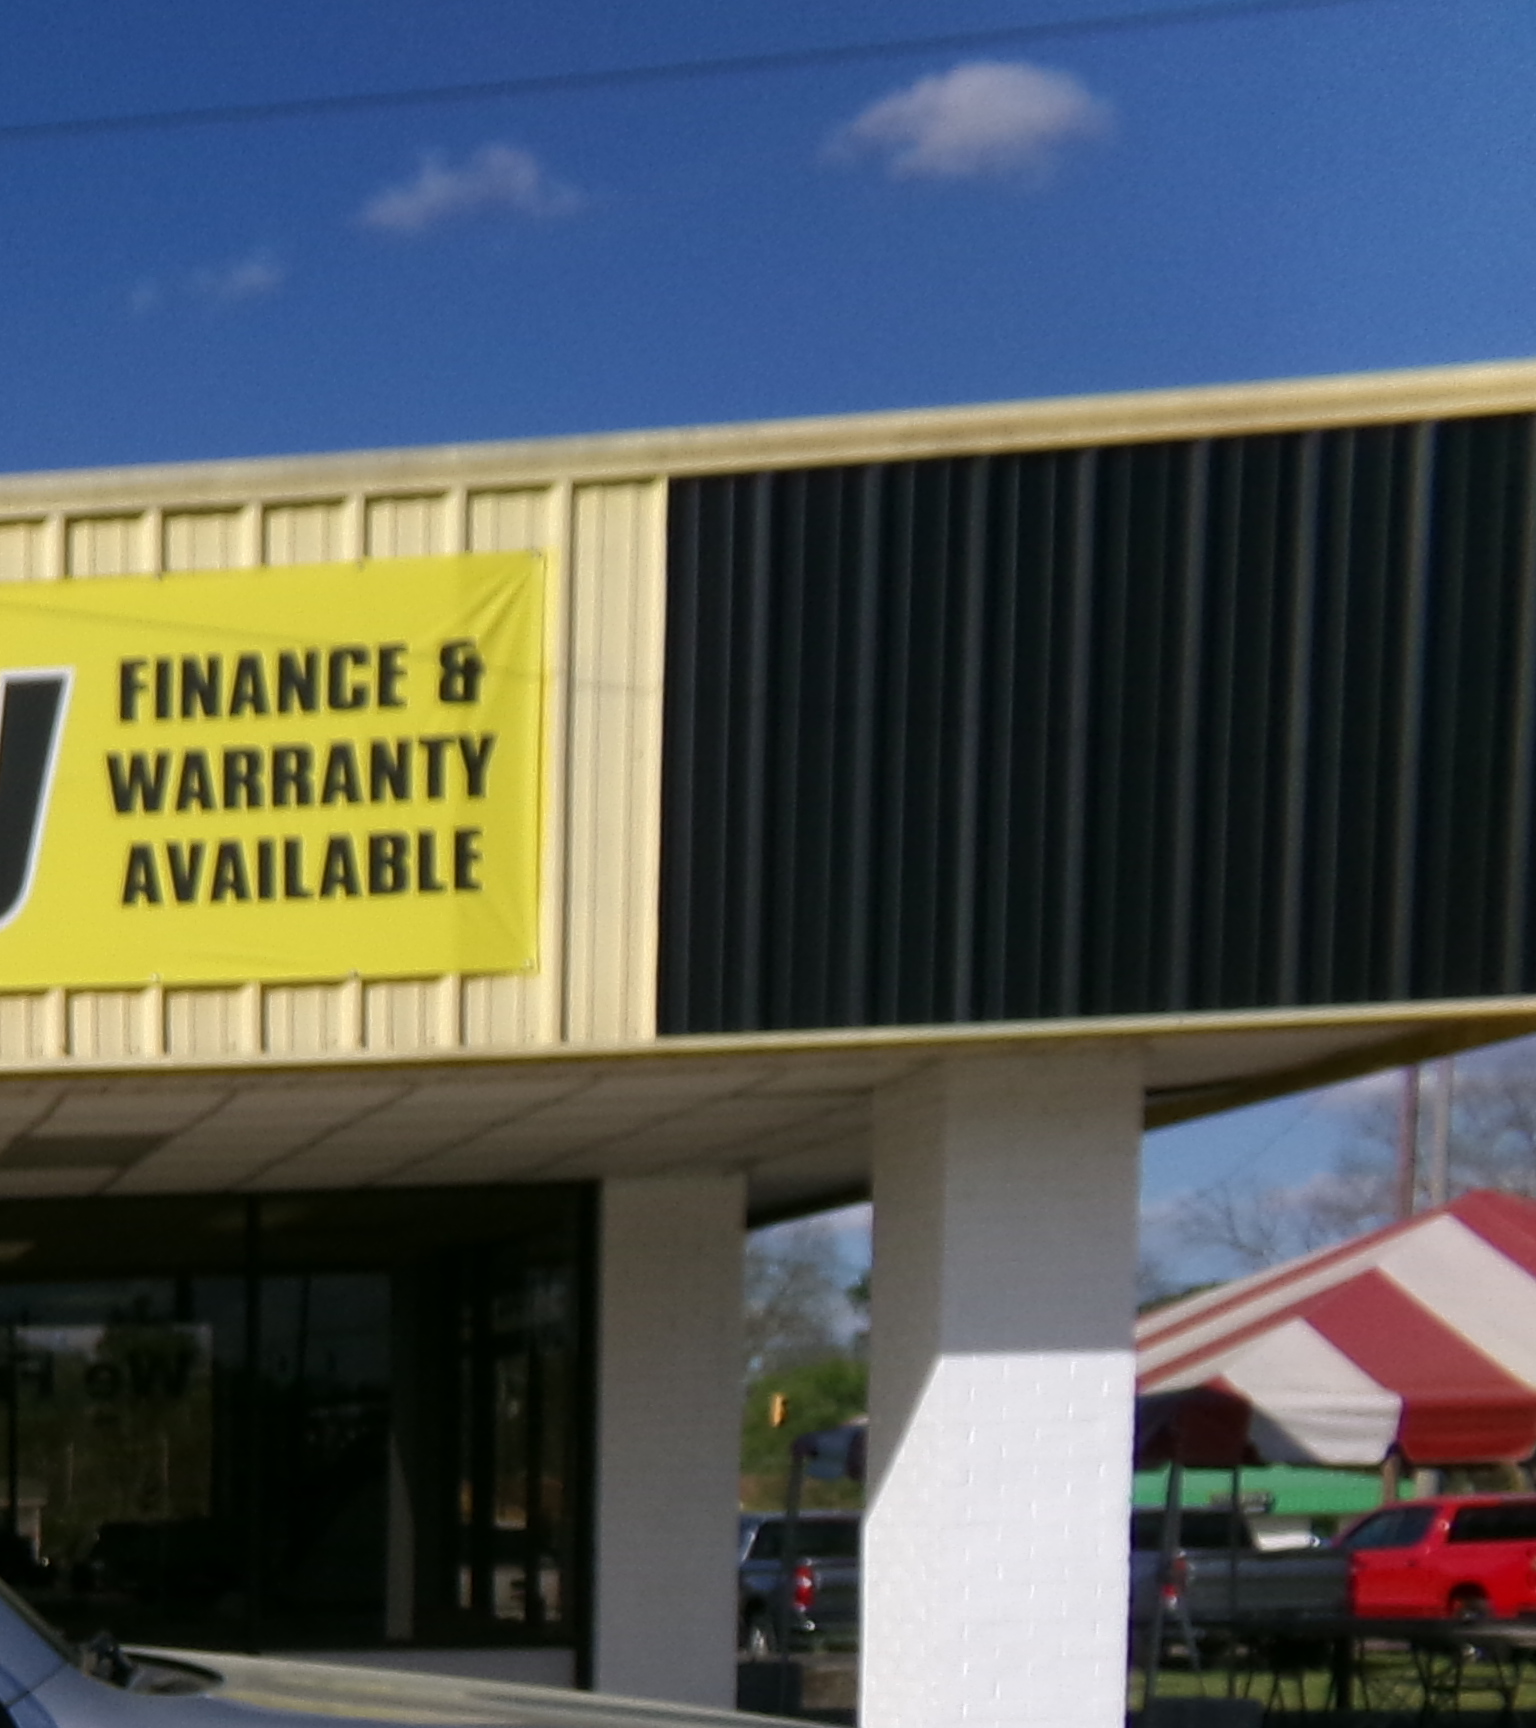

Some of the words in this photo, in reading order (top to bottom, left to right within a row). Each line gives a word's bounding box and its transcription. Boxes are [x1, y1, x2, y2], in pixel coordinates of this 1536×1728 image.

[117, 641, 408, 723] FINANCE
[438, 636, 485, 705] &
[106, 732, 496, 814] WARRANTY
[121, 827, 484, 908] AVAILABLE
